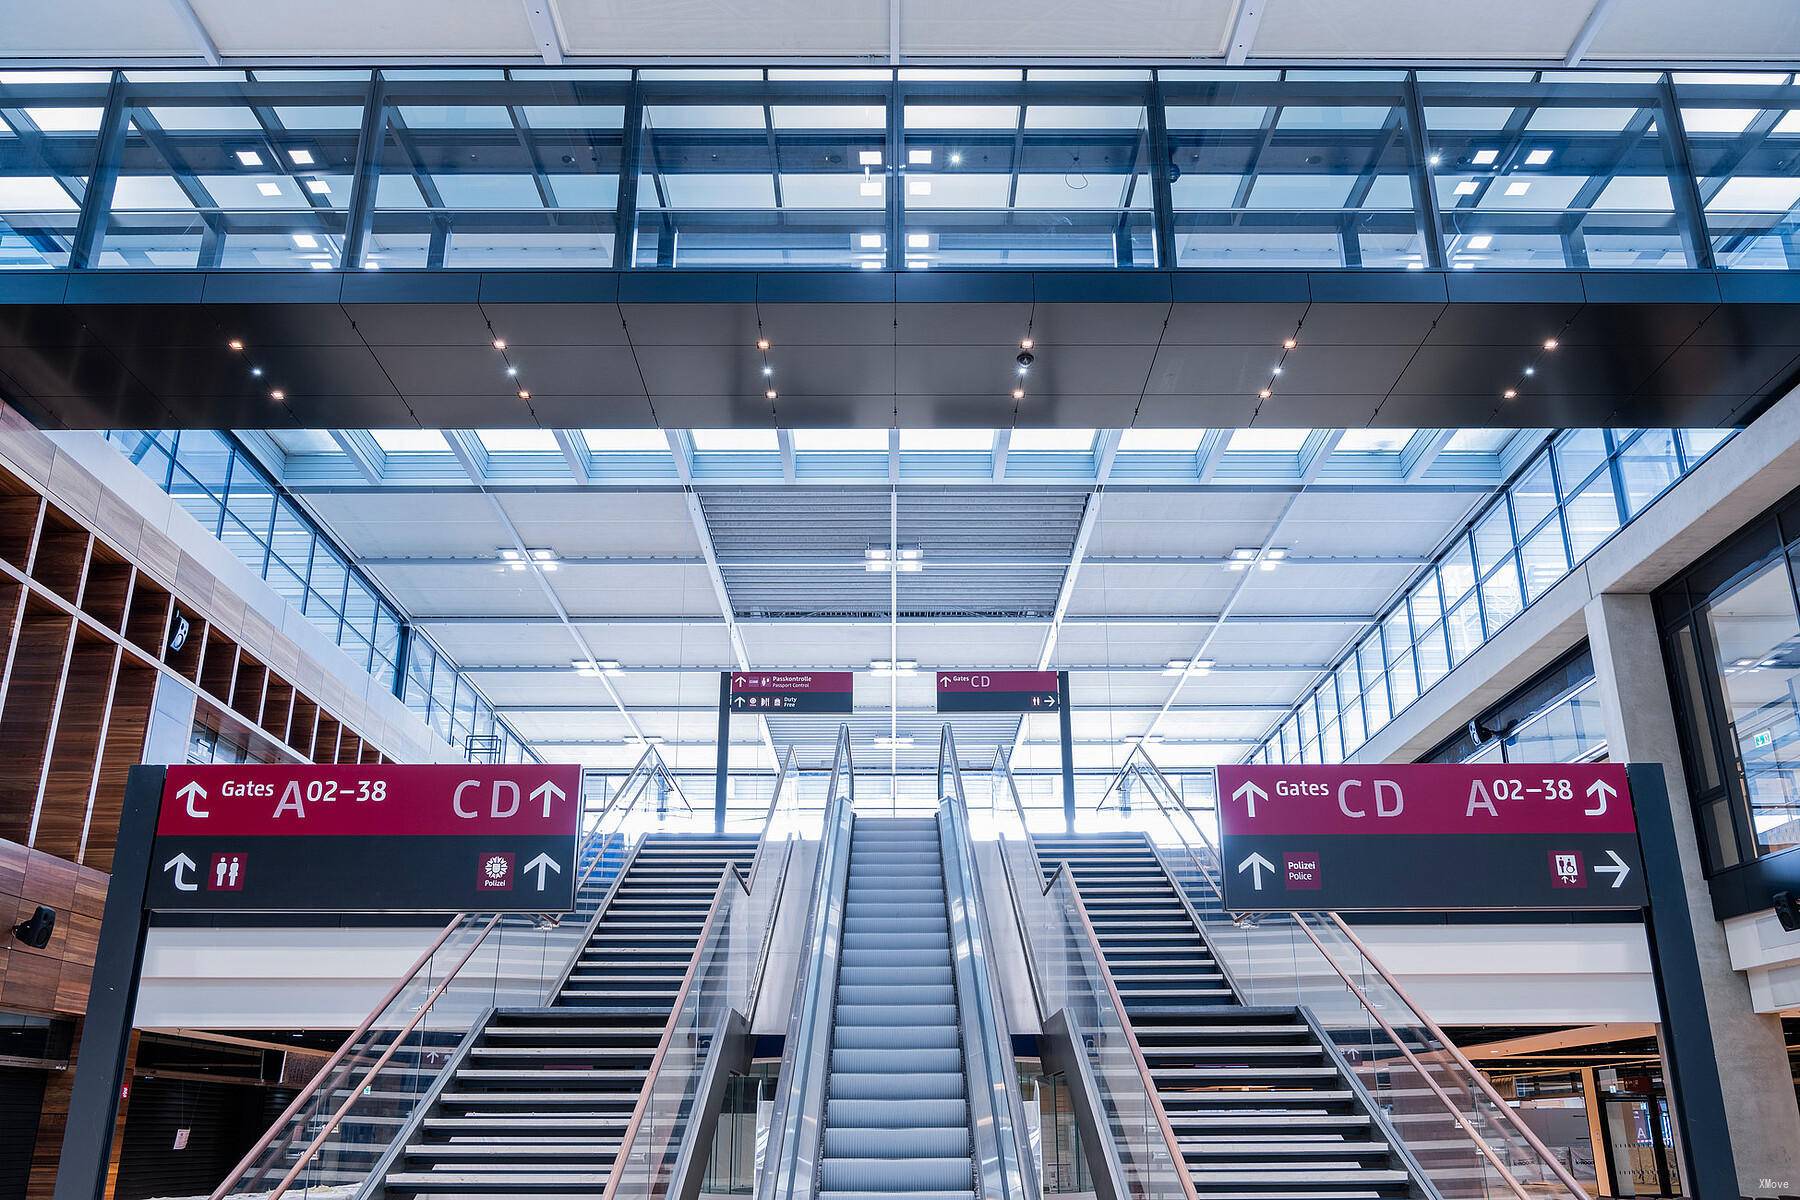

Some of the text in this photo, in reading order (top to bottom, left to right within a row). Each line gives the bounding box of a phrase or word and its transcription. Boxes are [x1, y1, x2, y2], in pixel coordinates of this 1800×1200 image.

[221, 780, 274, 797] Gates
[1276, 780, 1330, 797] Gates
[1288, 861, 1316, 870] Polizei
[1288, 872, 1313, 881] Police
[484, 879, 506, 887] Polizei
